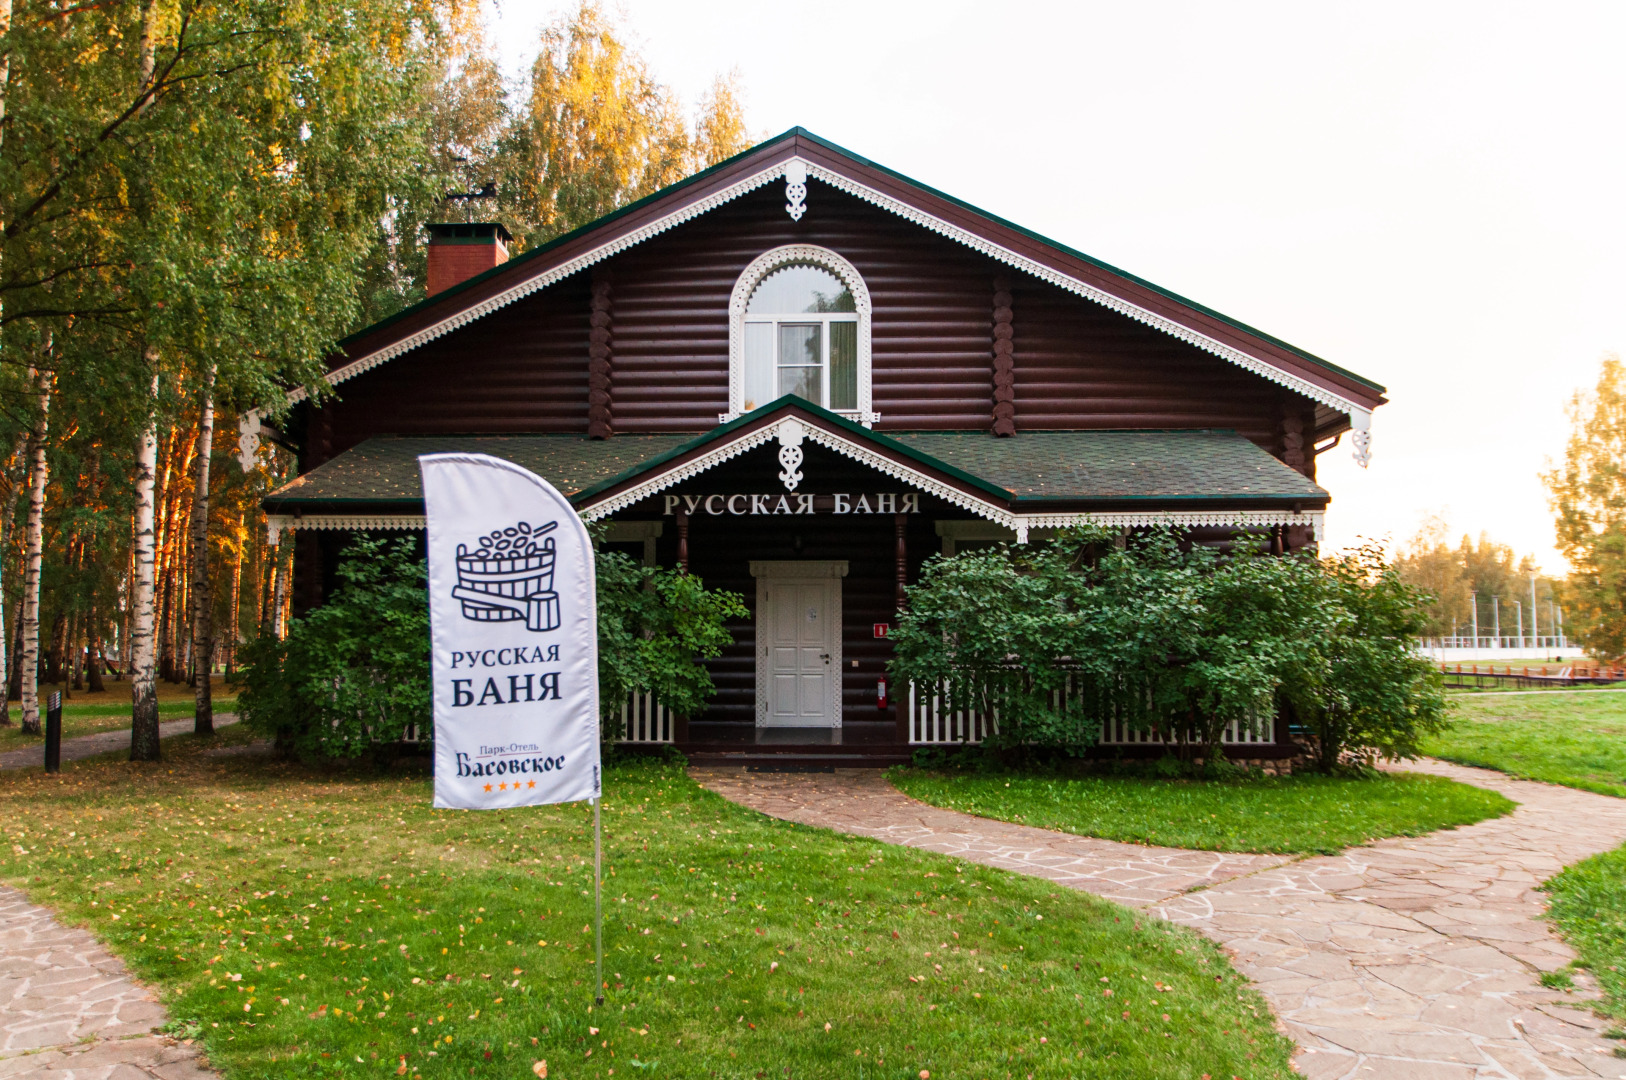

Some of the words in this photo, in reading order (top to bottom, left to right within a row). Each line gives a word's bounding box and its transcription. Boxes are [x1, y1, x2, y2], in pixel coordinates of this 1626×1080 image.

[663, 493, 815, 516] РУССКАЯ
[832, 493, 921, 514] БАНЯ
[451, 644, 560, 668] РУССКАЯ
[451, 672, 562, 707] БАНЯ
[480, 743, 539, 757] Парк-Отель
[456, 752, 565, 778] Басовское
